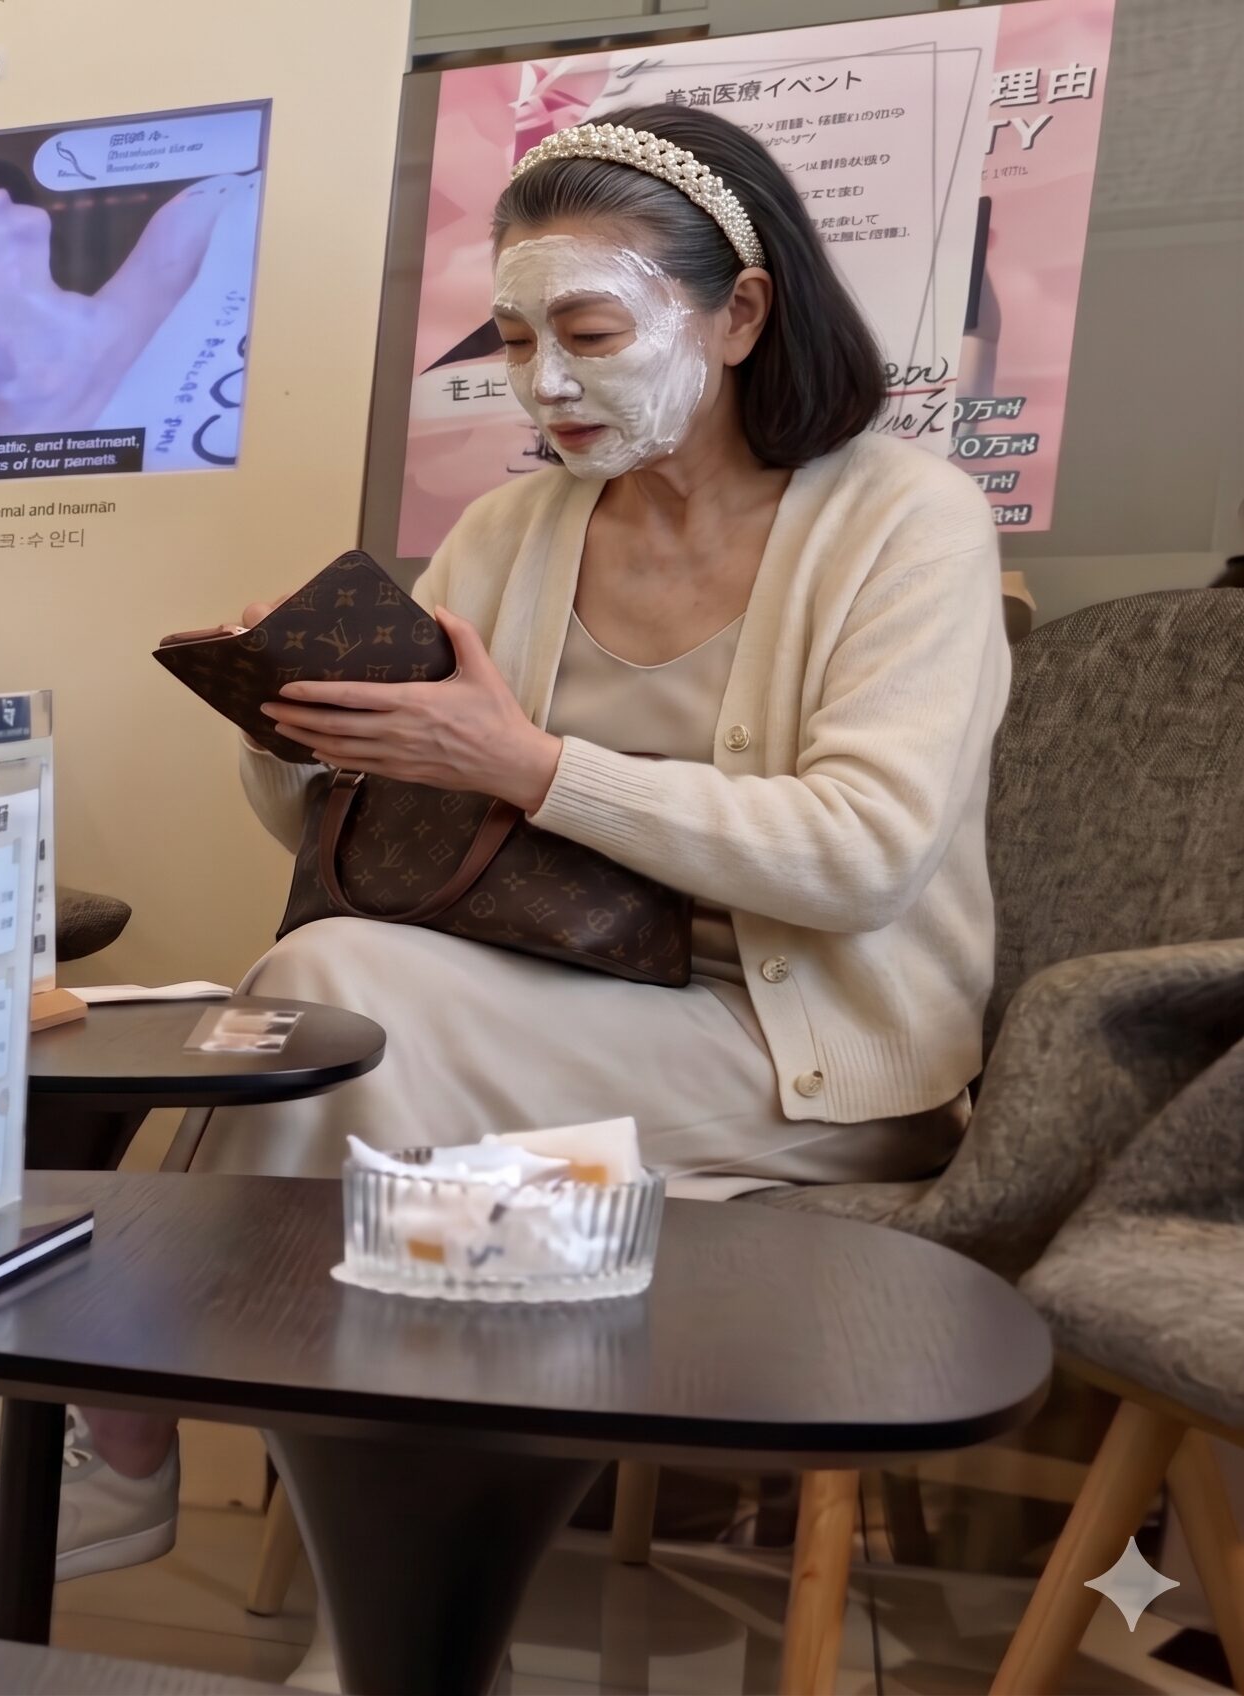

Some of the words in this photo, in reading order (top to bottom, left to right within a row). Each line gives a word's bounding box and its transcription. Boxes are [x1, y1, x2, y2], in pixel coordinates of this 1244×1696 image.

[13, 457, 28, 470] of
[31, 456, 59, 469] four
[28, 502, 54, 516] and
